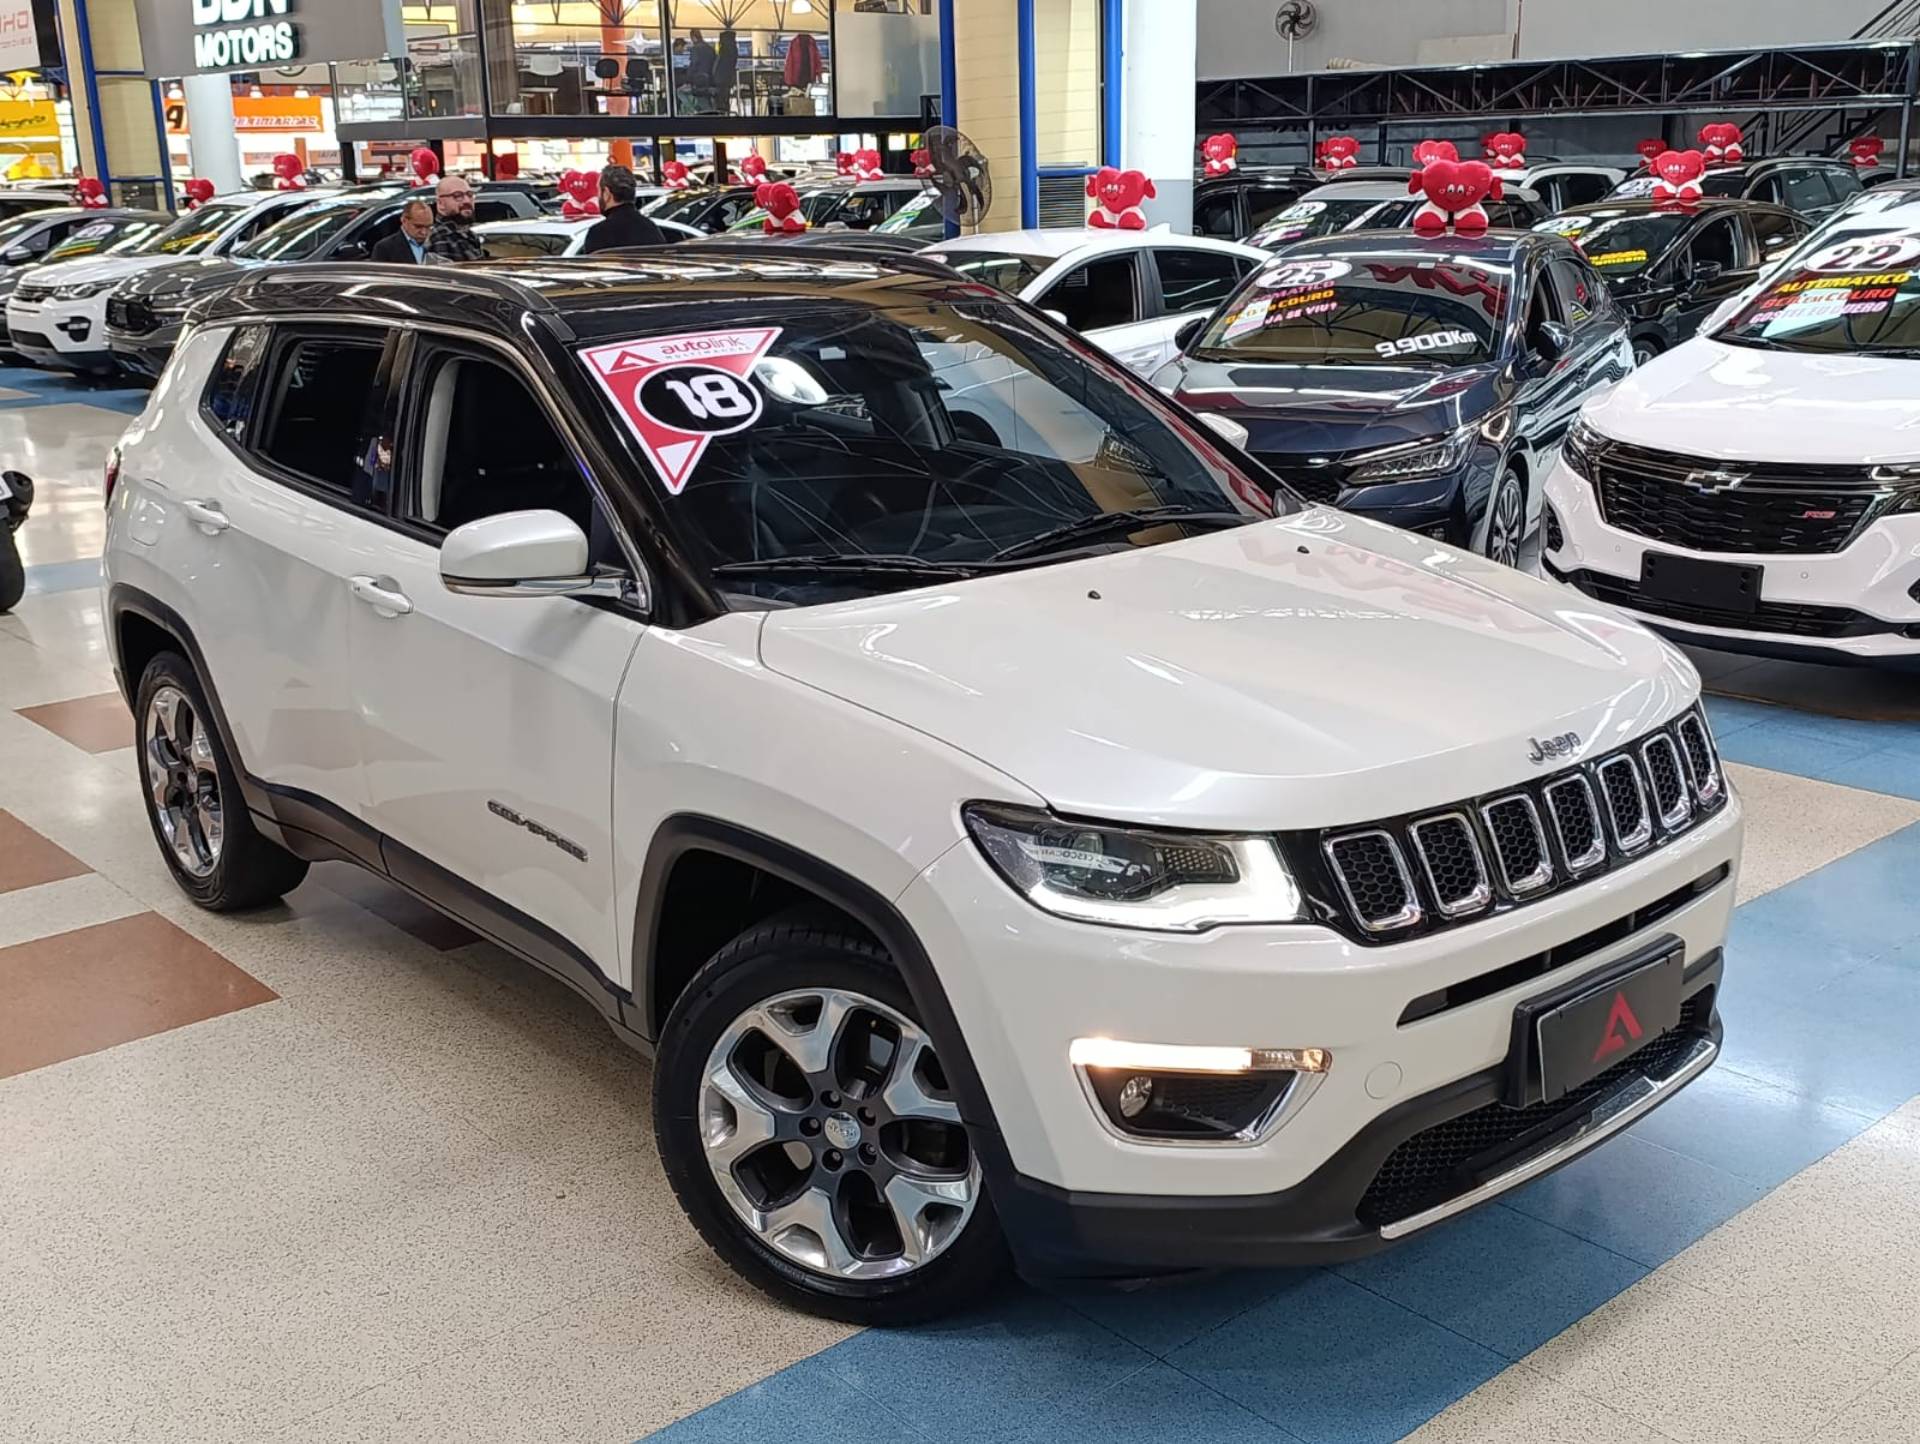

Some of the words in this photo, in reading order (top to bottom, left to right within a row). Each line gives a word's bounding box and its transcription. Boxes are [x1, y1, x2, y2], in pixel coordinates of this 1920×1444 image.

[194, 22, 293, 67] MOTORS
[1817, 245, 1902, 270] 22
[1268, 264, 1333, 287] 25
[1775, 273, 1912, 294] AUTOMATICO
[1278, 290, 1334, 309] COURO
[660, 336, 746, 354] autolink
[1375, 330, 1478, 358] 9.900Km
[665, 373, 753, 420] 18
[1527, 732, 1582, 763] Jeep
